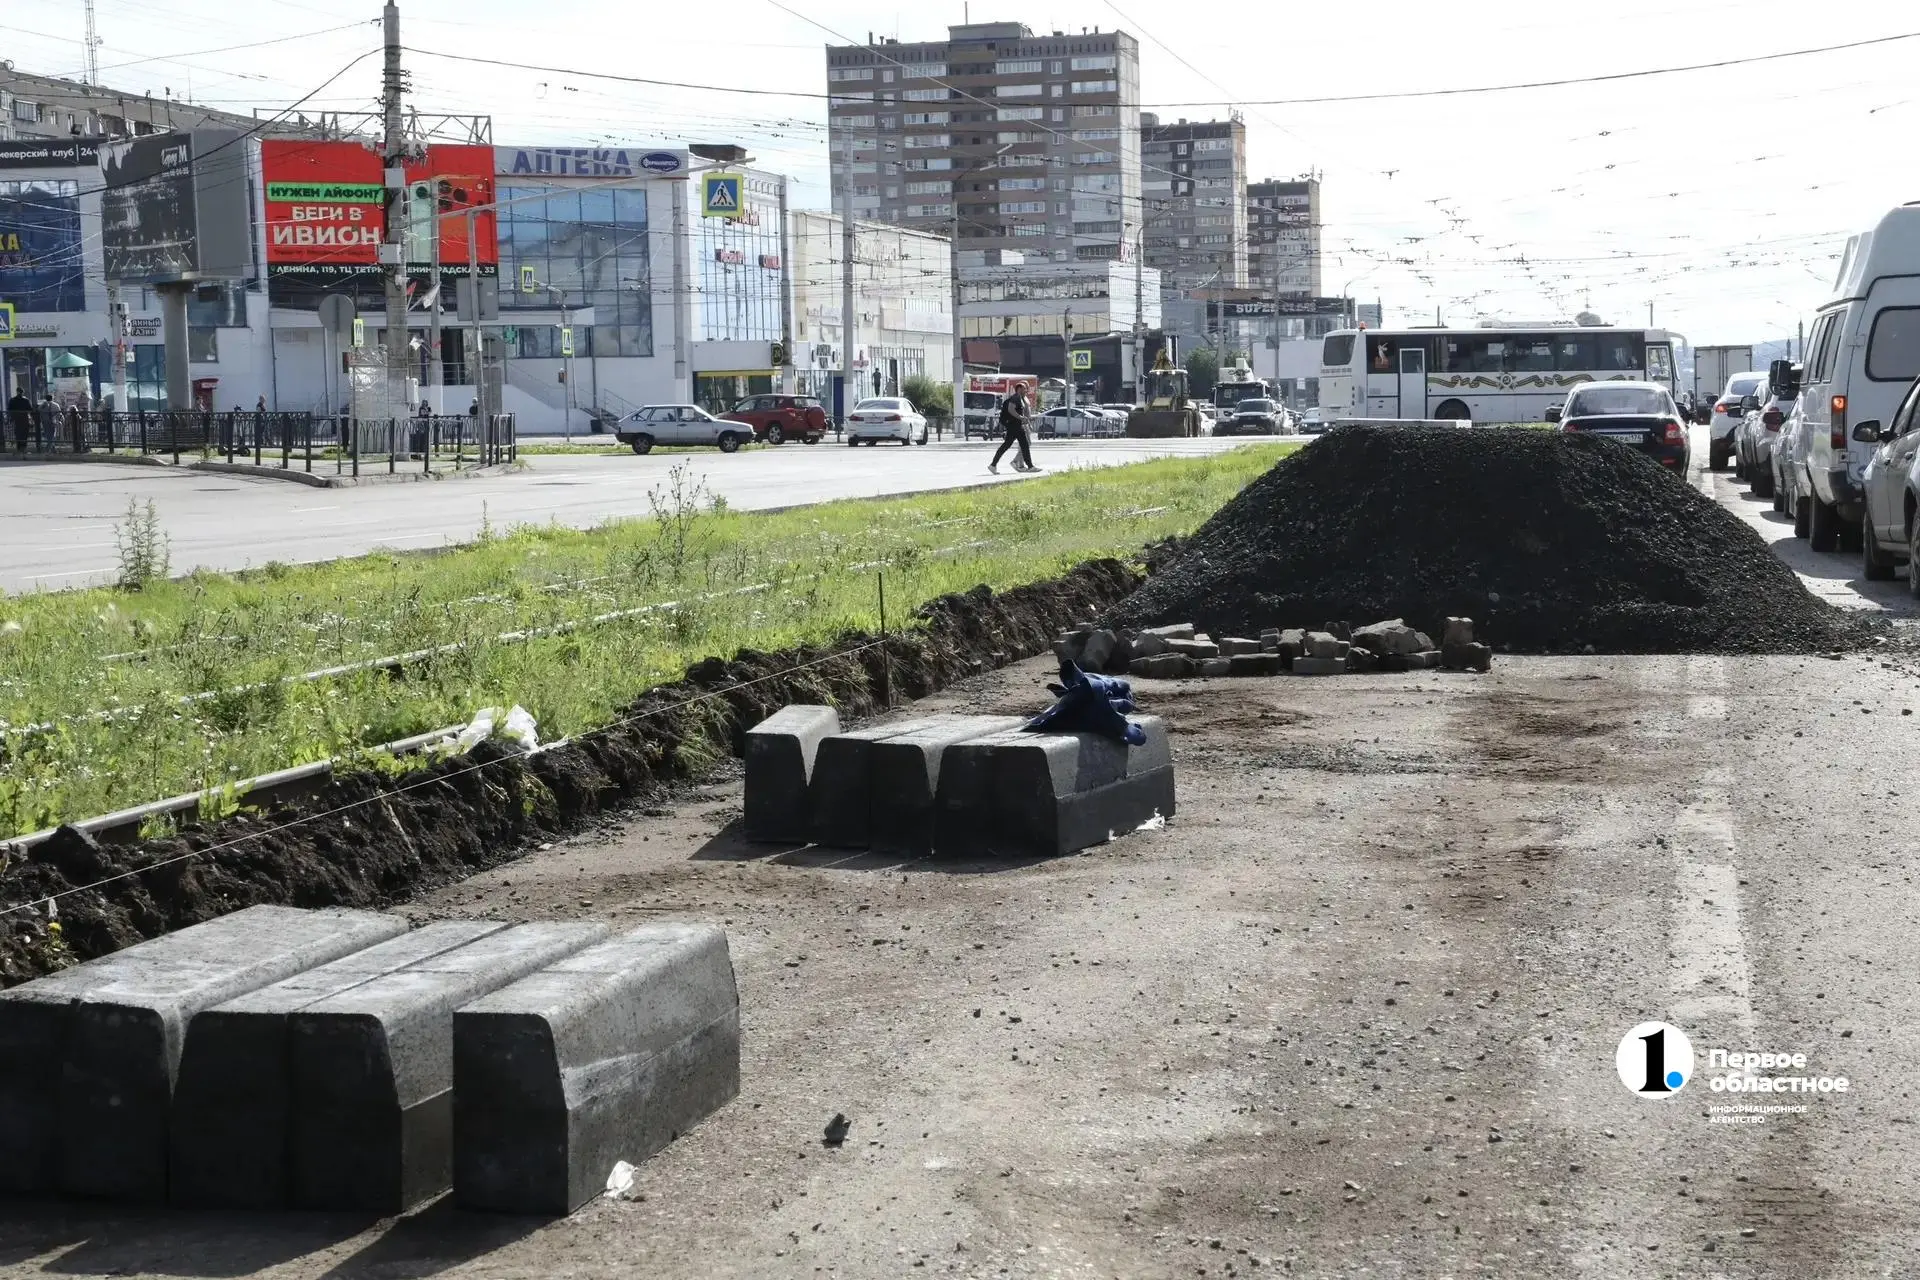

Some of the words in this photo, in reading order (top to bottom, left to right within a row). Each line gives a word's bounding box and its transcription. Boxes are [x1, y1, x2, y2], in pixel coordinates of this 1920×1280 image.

[52, 146, 75, 159] клуб
[512, 149, 633, 175] АПТЕКА
[271, 187, 320, 197] НУЖЕН
[292, 206, 343, 221] БЕГИ
[349, 207, 362, 221] В
[273, 225, 380, 246] ИВИОН
[277, 266, 319, 274] ЛЕНИНА,
[322, 266, 337, 274] 119,
[339, 266, 353, 275] ТЦ
